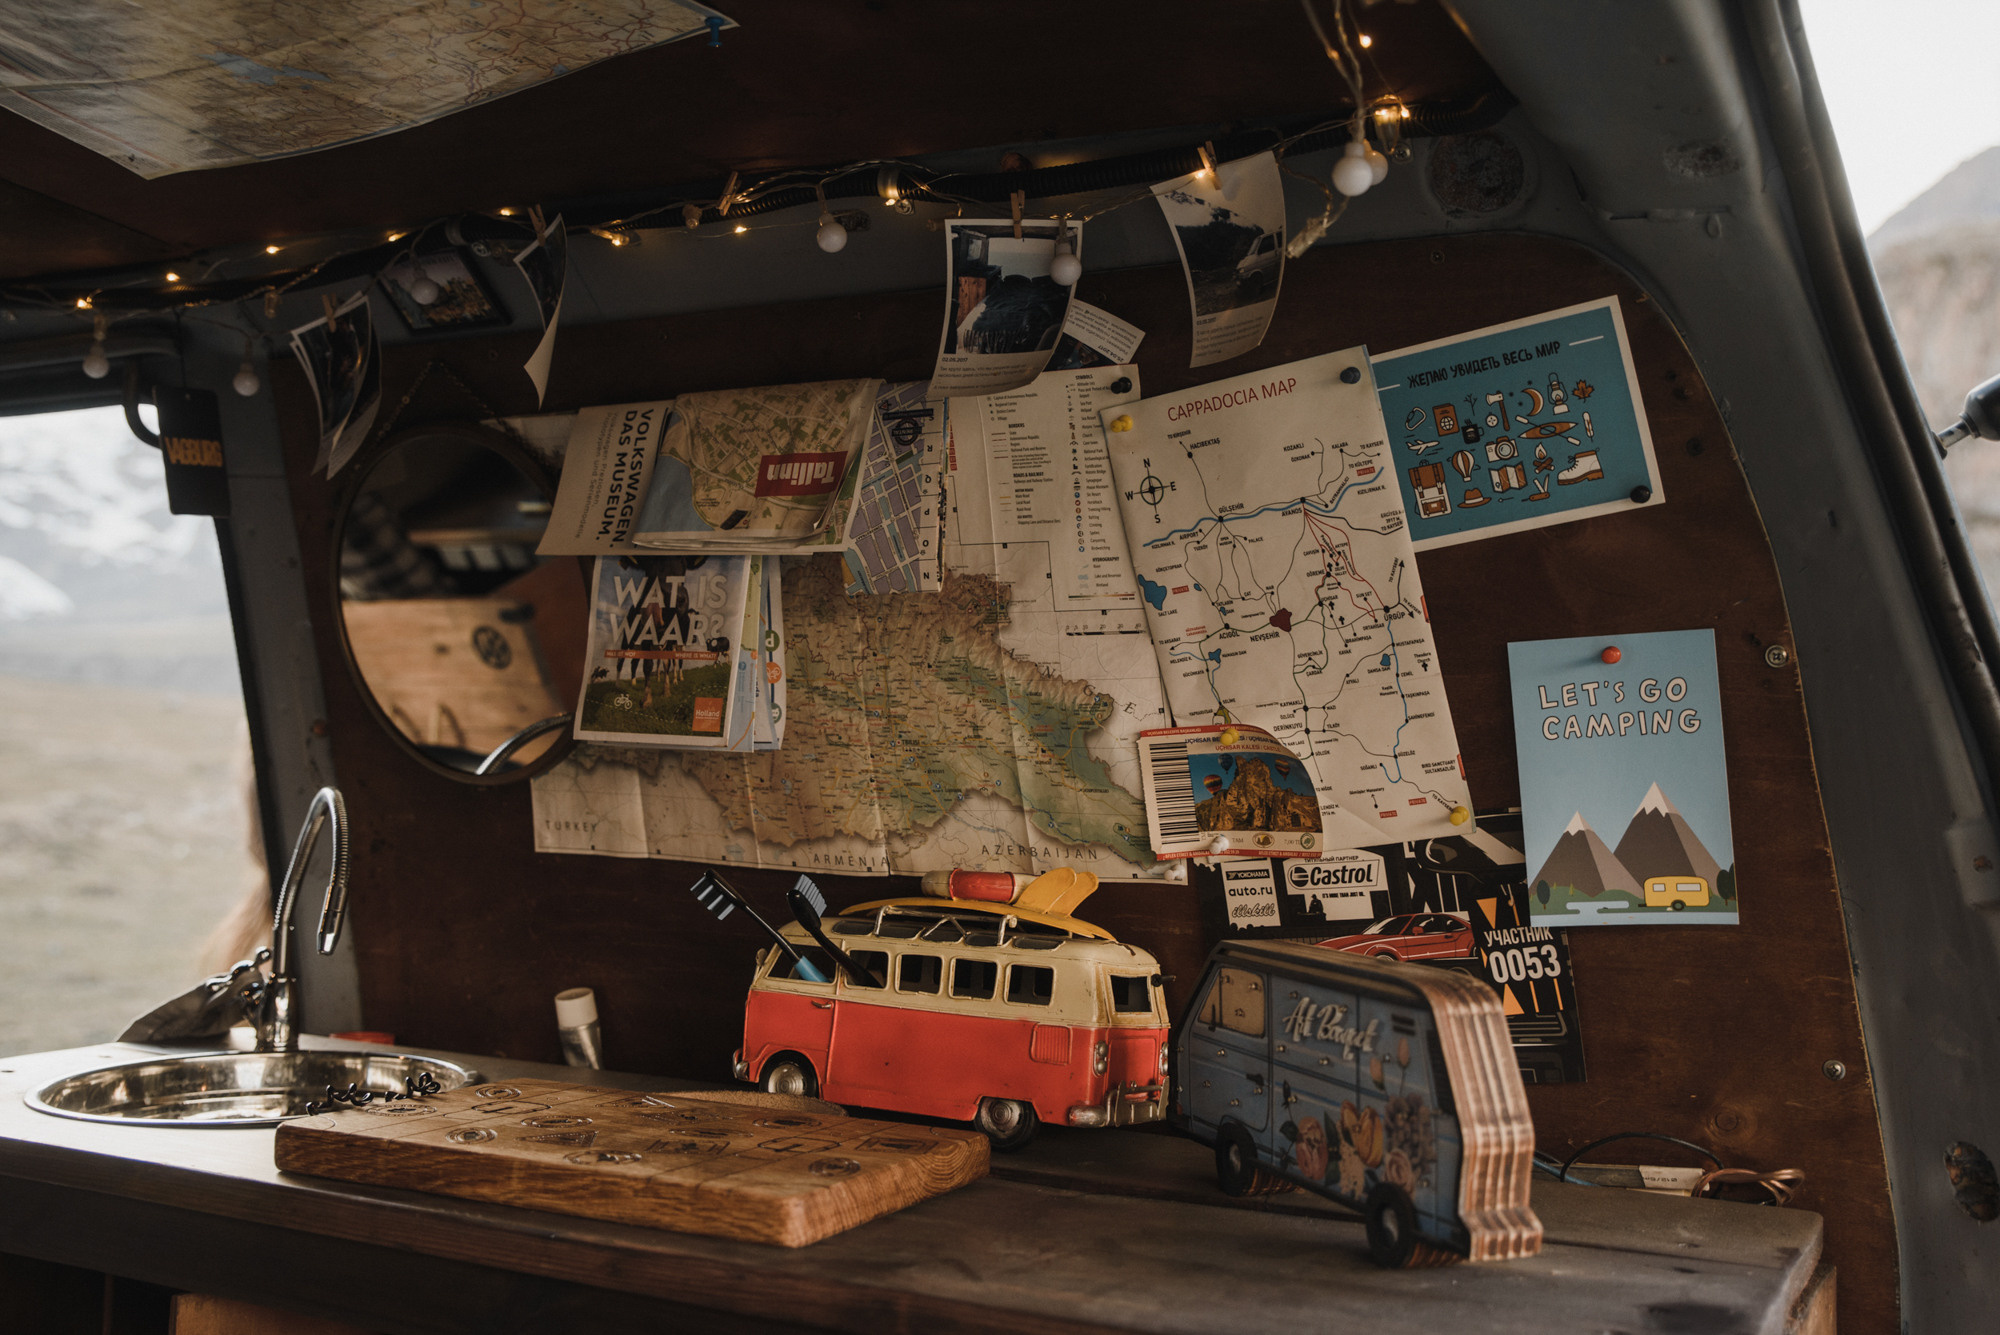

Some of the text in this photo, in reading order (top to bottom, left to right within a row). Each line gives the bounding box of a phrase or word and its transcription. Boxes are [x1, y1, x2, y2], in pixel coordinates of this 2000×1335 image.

[1407, 340, 1561, 389] ЖЕЛАЮ УВИДЕТЬ ВЕСЬ МИР
[1167, 377, 1297, 422] CAPPADOCIA MAP
[1189, 437, 1221, 450] HACIBEKTAŞ
[1283, 443, 1304, 452] KOZAKLI
[1331, 442, 1349, 450] KALABA
[1143, 458, 1151, 468] N
[596, 410, 638, 541] DAS MUSEUM.
[609, 409, 654, 548] VOLKSWAGEN.
[766, 461, 835, 486] Tallinn
[1170, 481, 1177, 491] E
[1125, 491, 1134, 501] W
[1281, 508, 1303, 517] AVANOS
[1154, 514, 1161, 524] S
[1179, 532, 1199, 540] AIRPORT
[613, 575, 686, 609] WAT
[695, 574, 728, 609] IS
[1384, 612, 1406, 622] ÜRGÜP
[1219, 631, 1240, 640] ACIGÖL
[1250, 631, 1280, 642] NEVŞEHİR
[1538, 676, 1687, 710] LET'S GO
[1280, 700, 1303, 708] KAYMAKLI
[695, 709, 720, 718] Holland
[1273, 723, 1303, 732] DERİNKUYU
[1542, 708, 1701, 740] CAMPING
[1432, 760, 1456, 768] SANCTUARY
[545, 820, 598, 834] TURKEY
[981, 844, 1098, 860] AZERBAIJAN
[813, 852, 888, 867] ARMENIA
[1237, 870, 1269, 879] YOKOHAMA
[1310, 864, 1373, 886] Castrol
[1228, 886, 1273, 897] auto.ru
[1483, 926, 1554, 948] УЧАСТНИК
[1489, 944, 1562, 985] 0053
